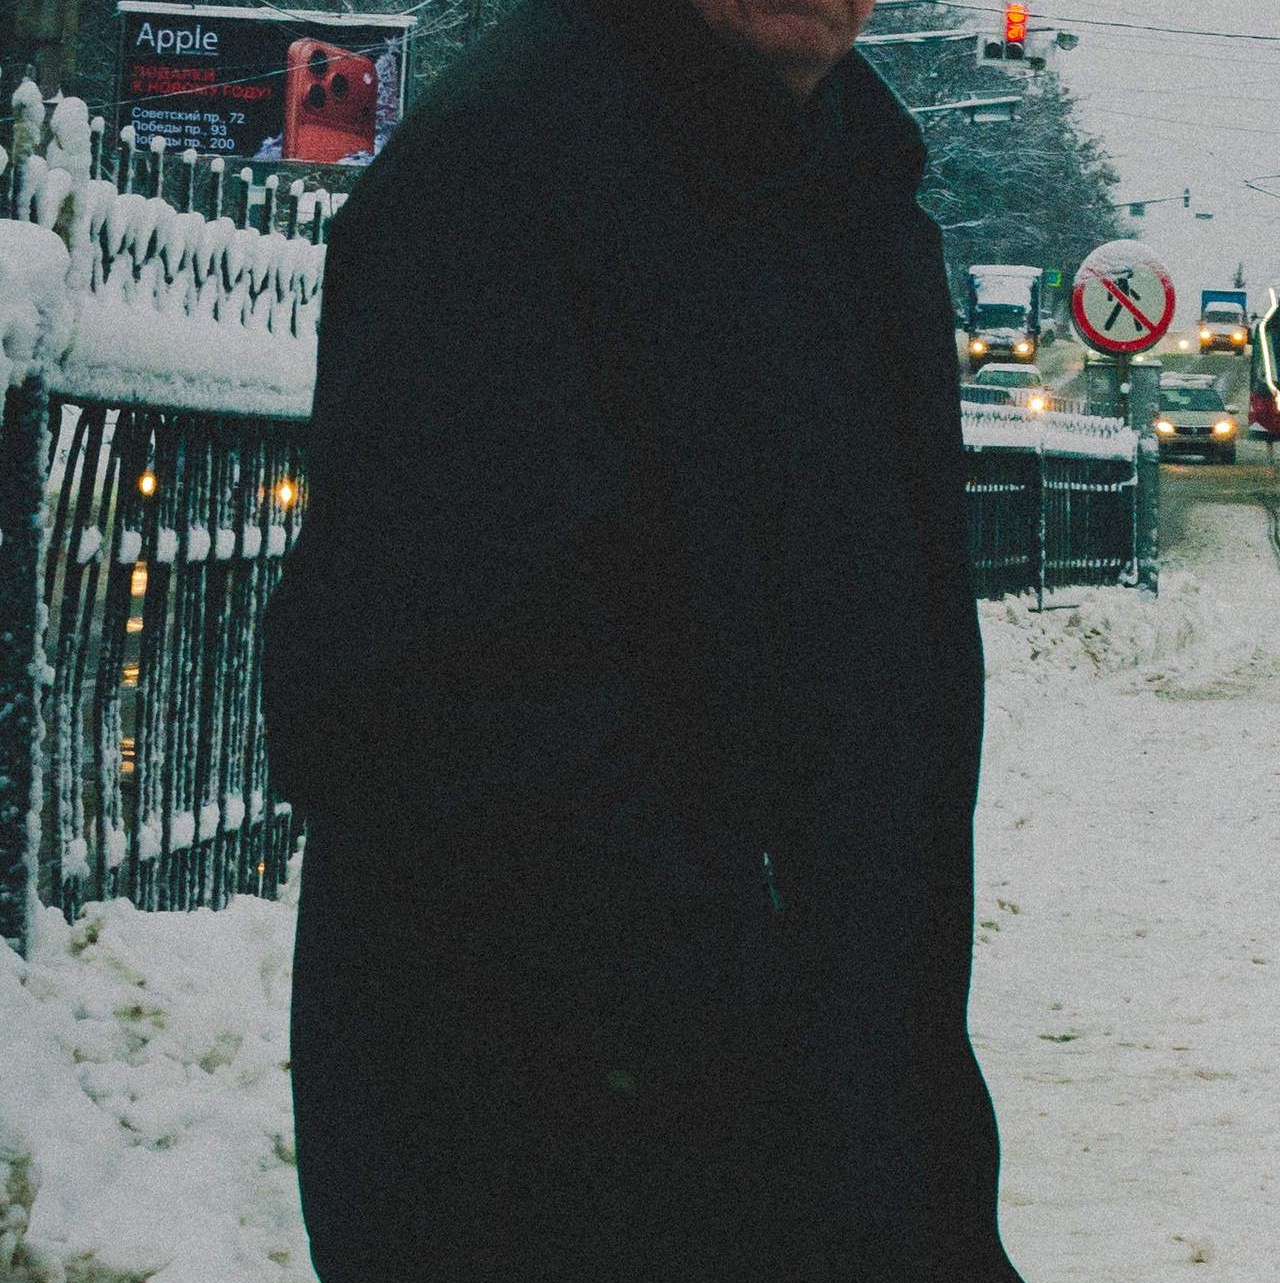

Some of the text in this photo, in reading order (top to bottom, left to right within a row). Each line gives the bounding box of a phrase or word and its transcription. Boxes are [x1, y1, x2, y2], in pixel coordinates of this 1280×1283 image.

[136, 22, 219, 54] Apple
[133, 65, 216, 81] ПОДАРКИ
[132, 81, 272, 100] К НОВОМУ ГОДУ!
[131, 107, 200, 121] Советский
[229, 113, 245, 124] 72
[131, 120, 182, 133] Победы
[210, 125, 227, 136] 93
[210, 138, 235, 150] 200
